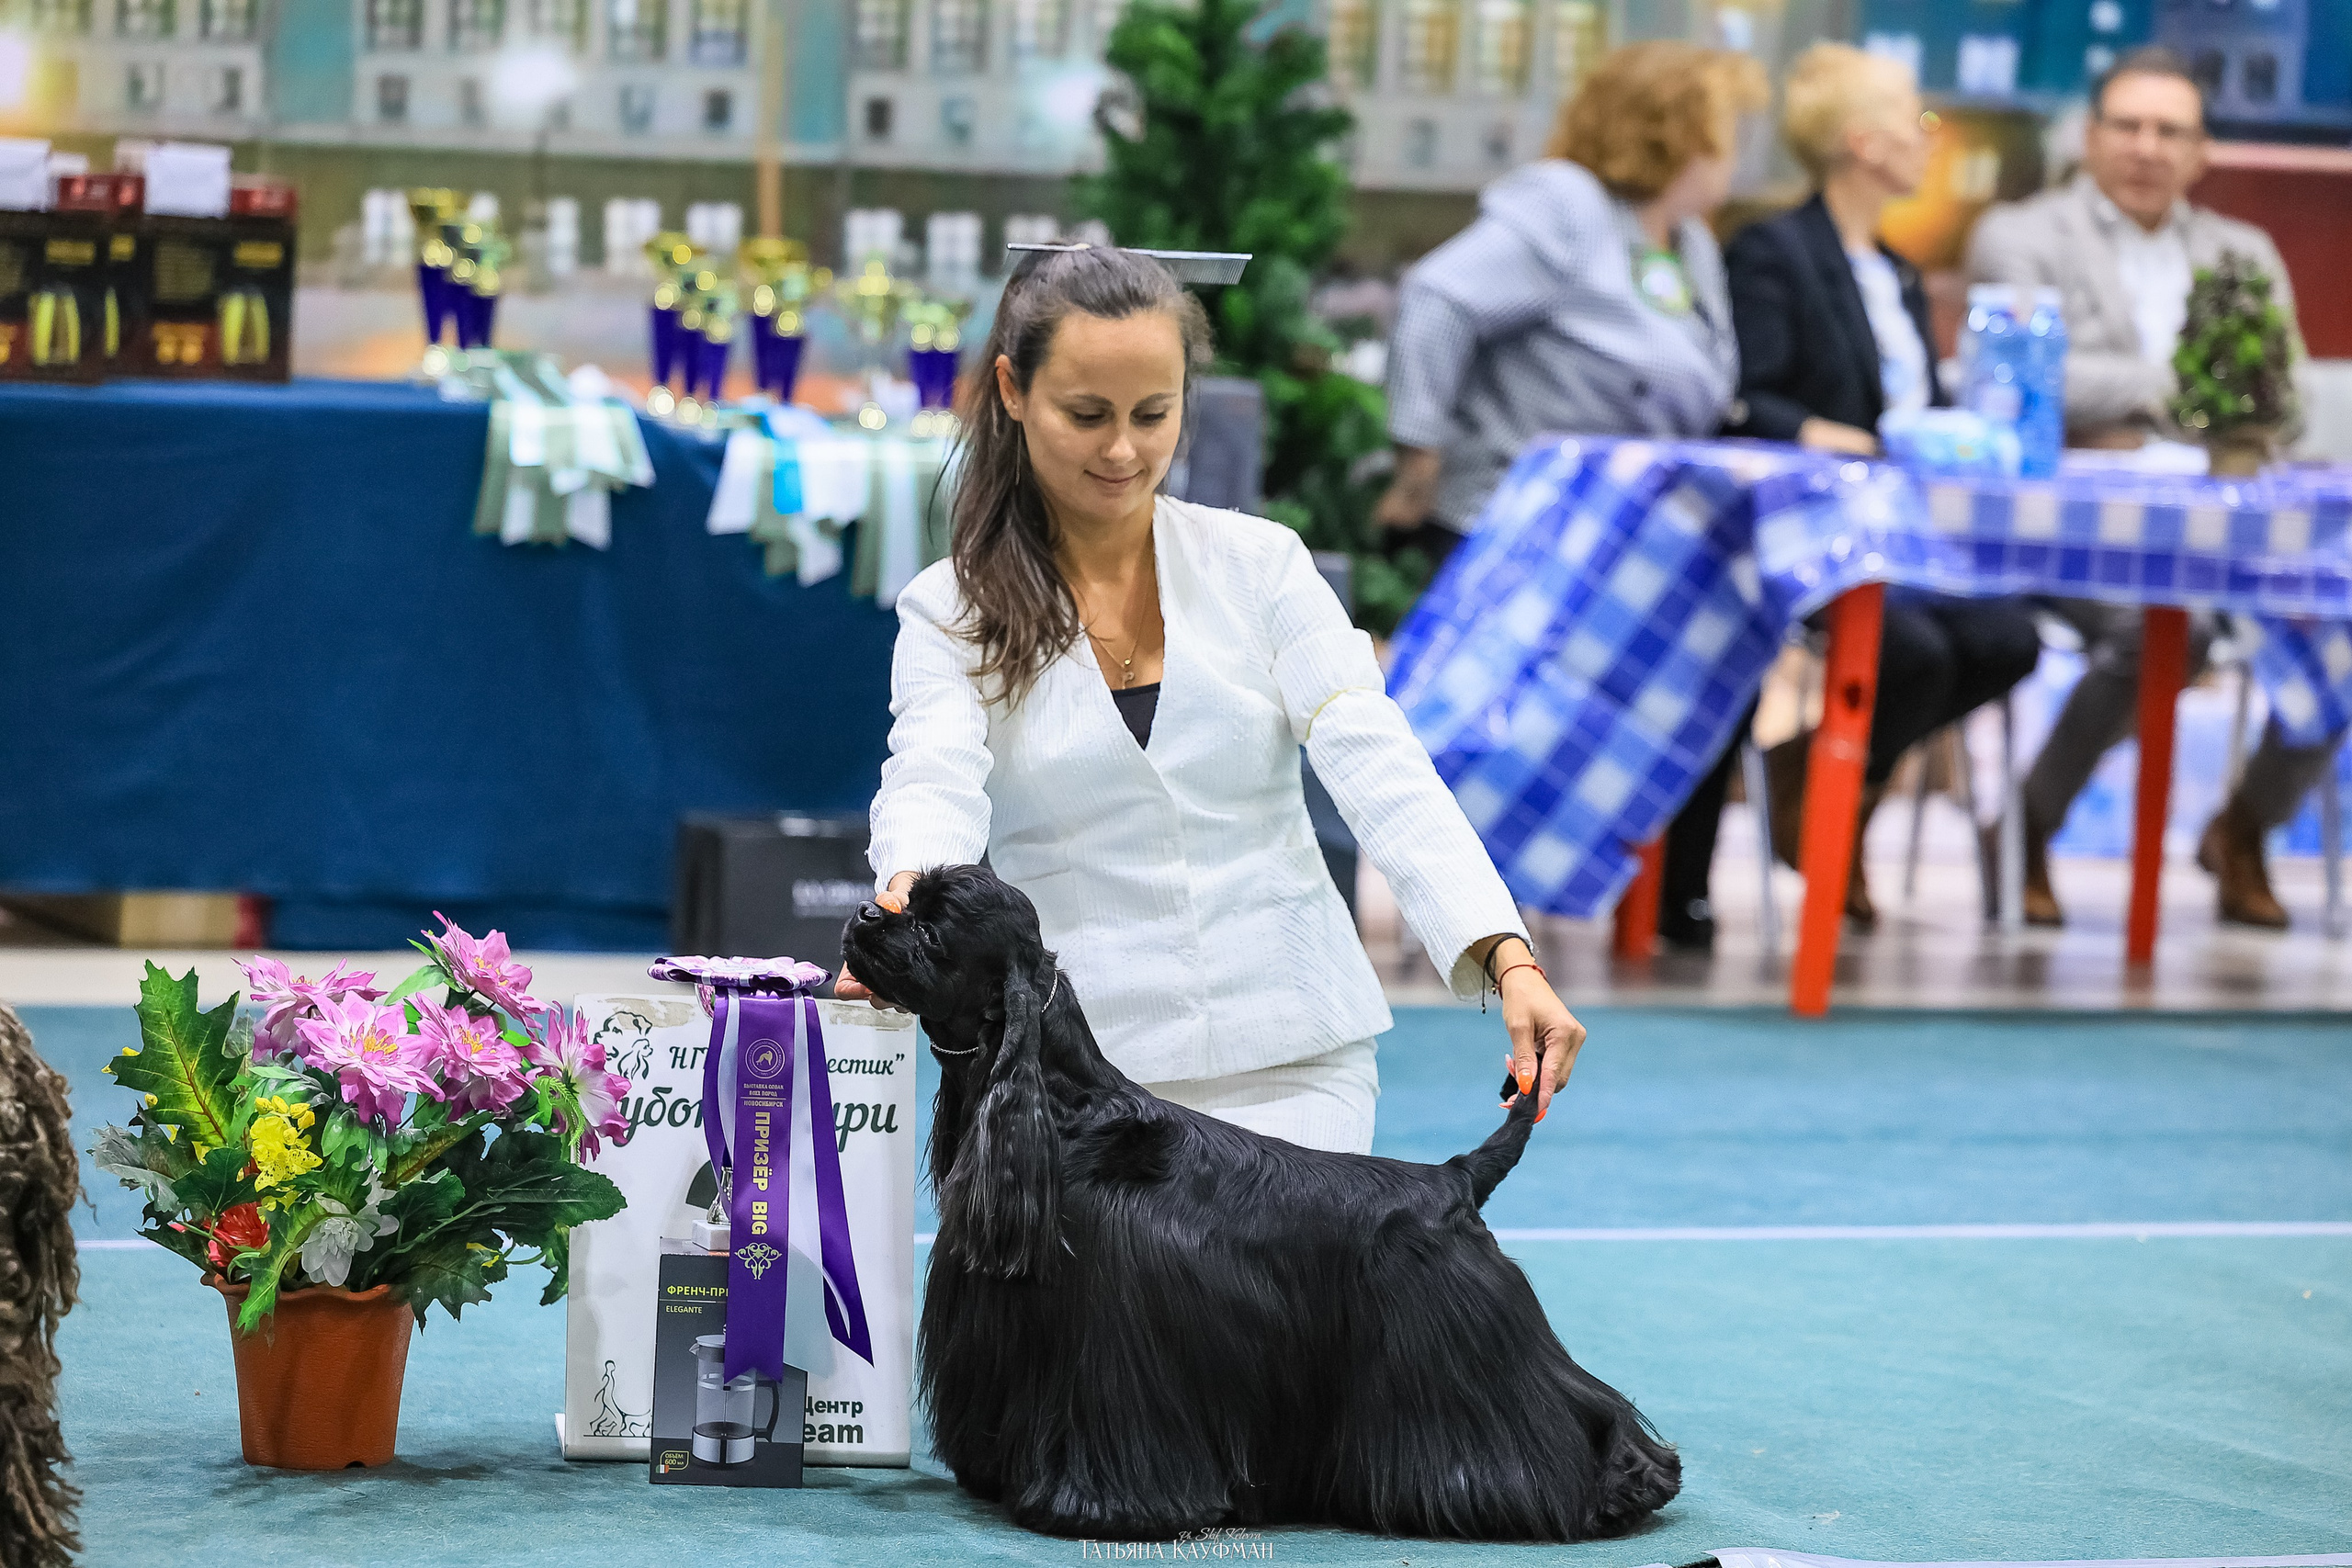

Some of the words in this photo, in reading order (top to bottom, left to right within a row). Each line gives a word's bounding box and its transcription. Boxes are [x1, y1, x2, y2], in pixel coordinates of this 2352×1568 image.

[752, 1111, 774, 1191] ПРИЗЁР
[751, 1201, 769, 1235] BIG
[667, 1285, 729, 1297] ФРЕНЧ-ПР
[665, 1305, 703, 1314] ELEGANTE
